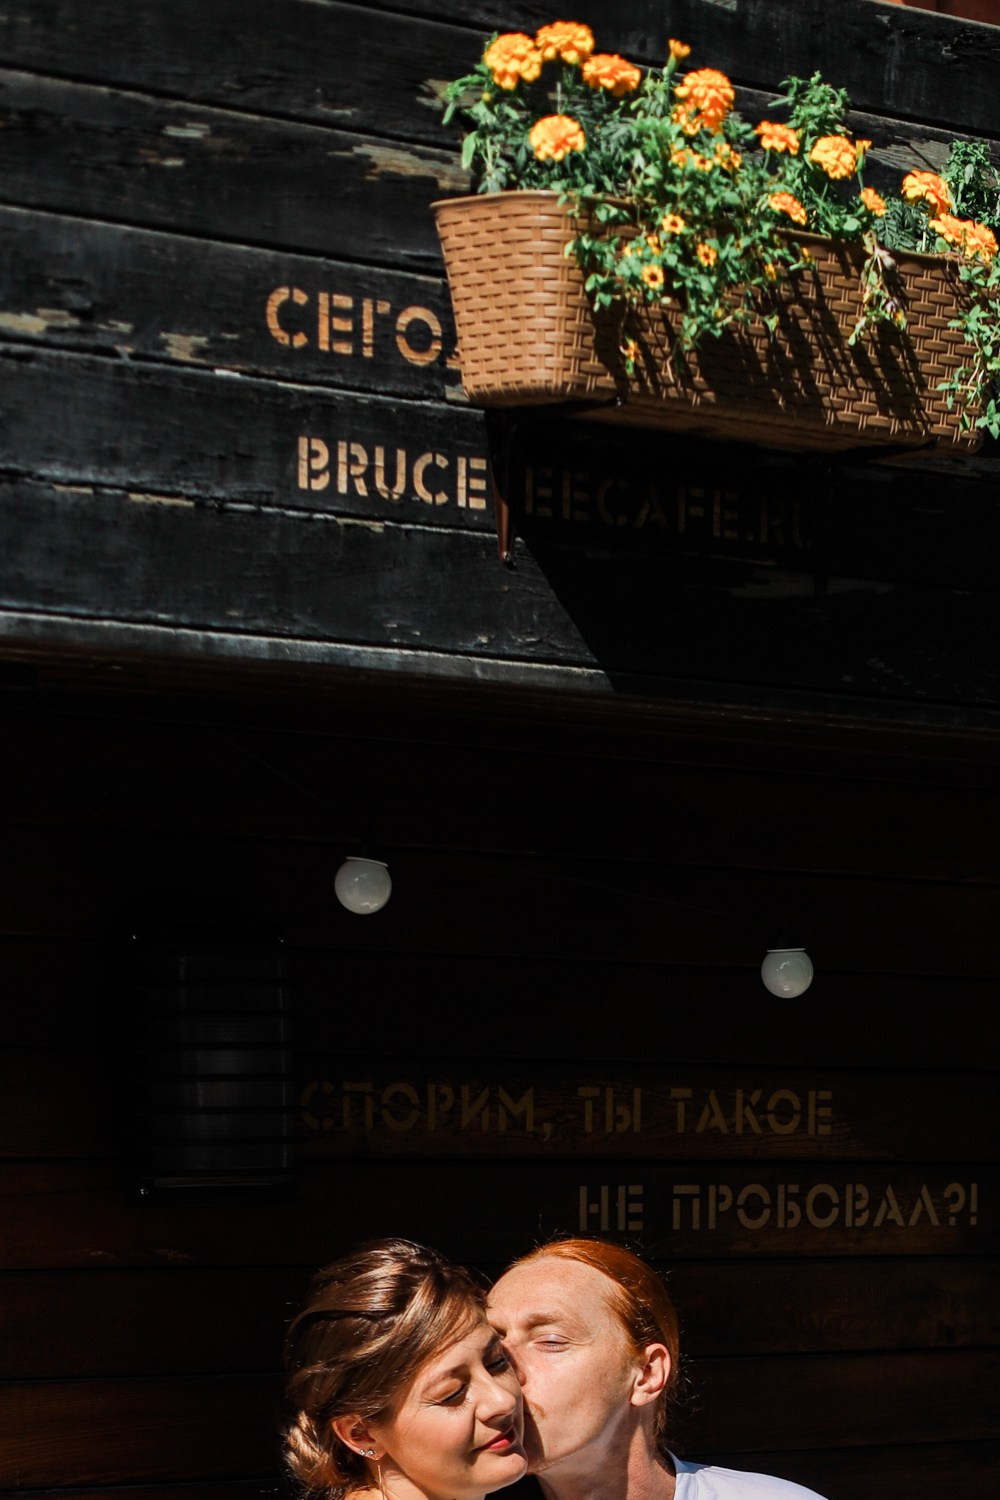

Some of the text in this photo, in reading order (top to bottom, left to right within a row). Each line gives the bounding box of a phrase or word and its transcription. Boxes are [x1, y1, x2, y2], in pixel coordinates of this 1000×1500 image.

[265, 285, 463, 370] СЕГО
[299, 1080, 835, 1143] СПОРИМ, ТЫ ТАКОЕ
[578, 1182, 979, 1232] НЕ ПРОБОВАЛ?!
